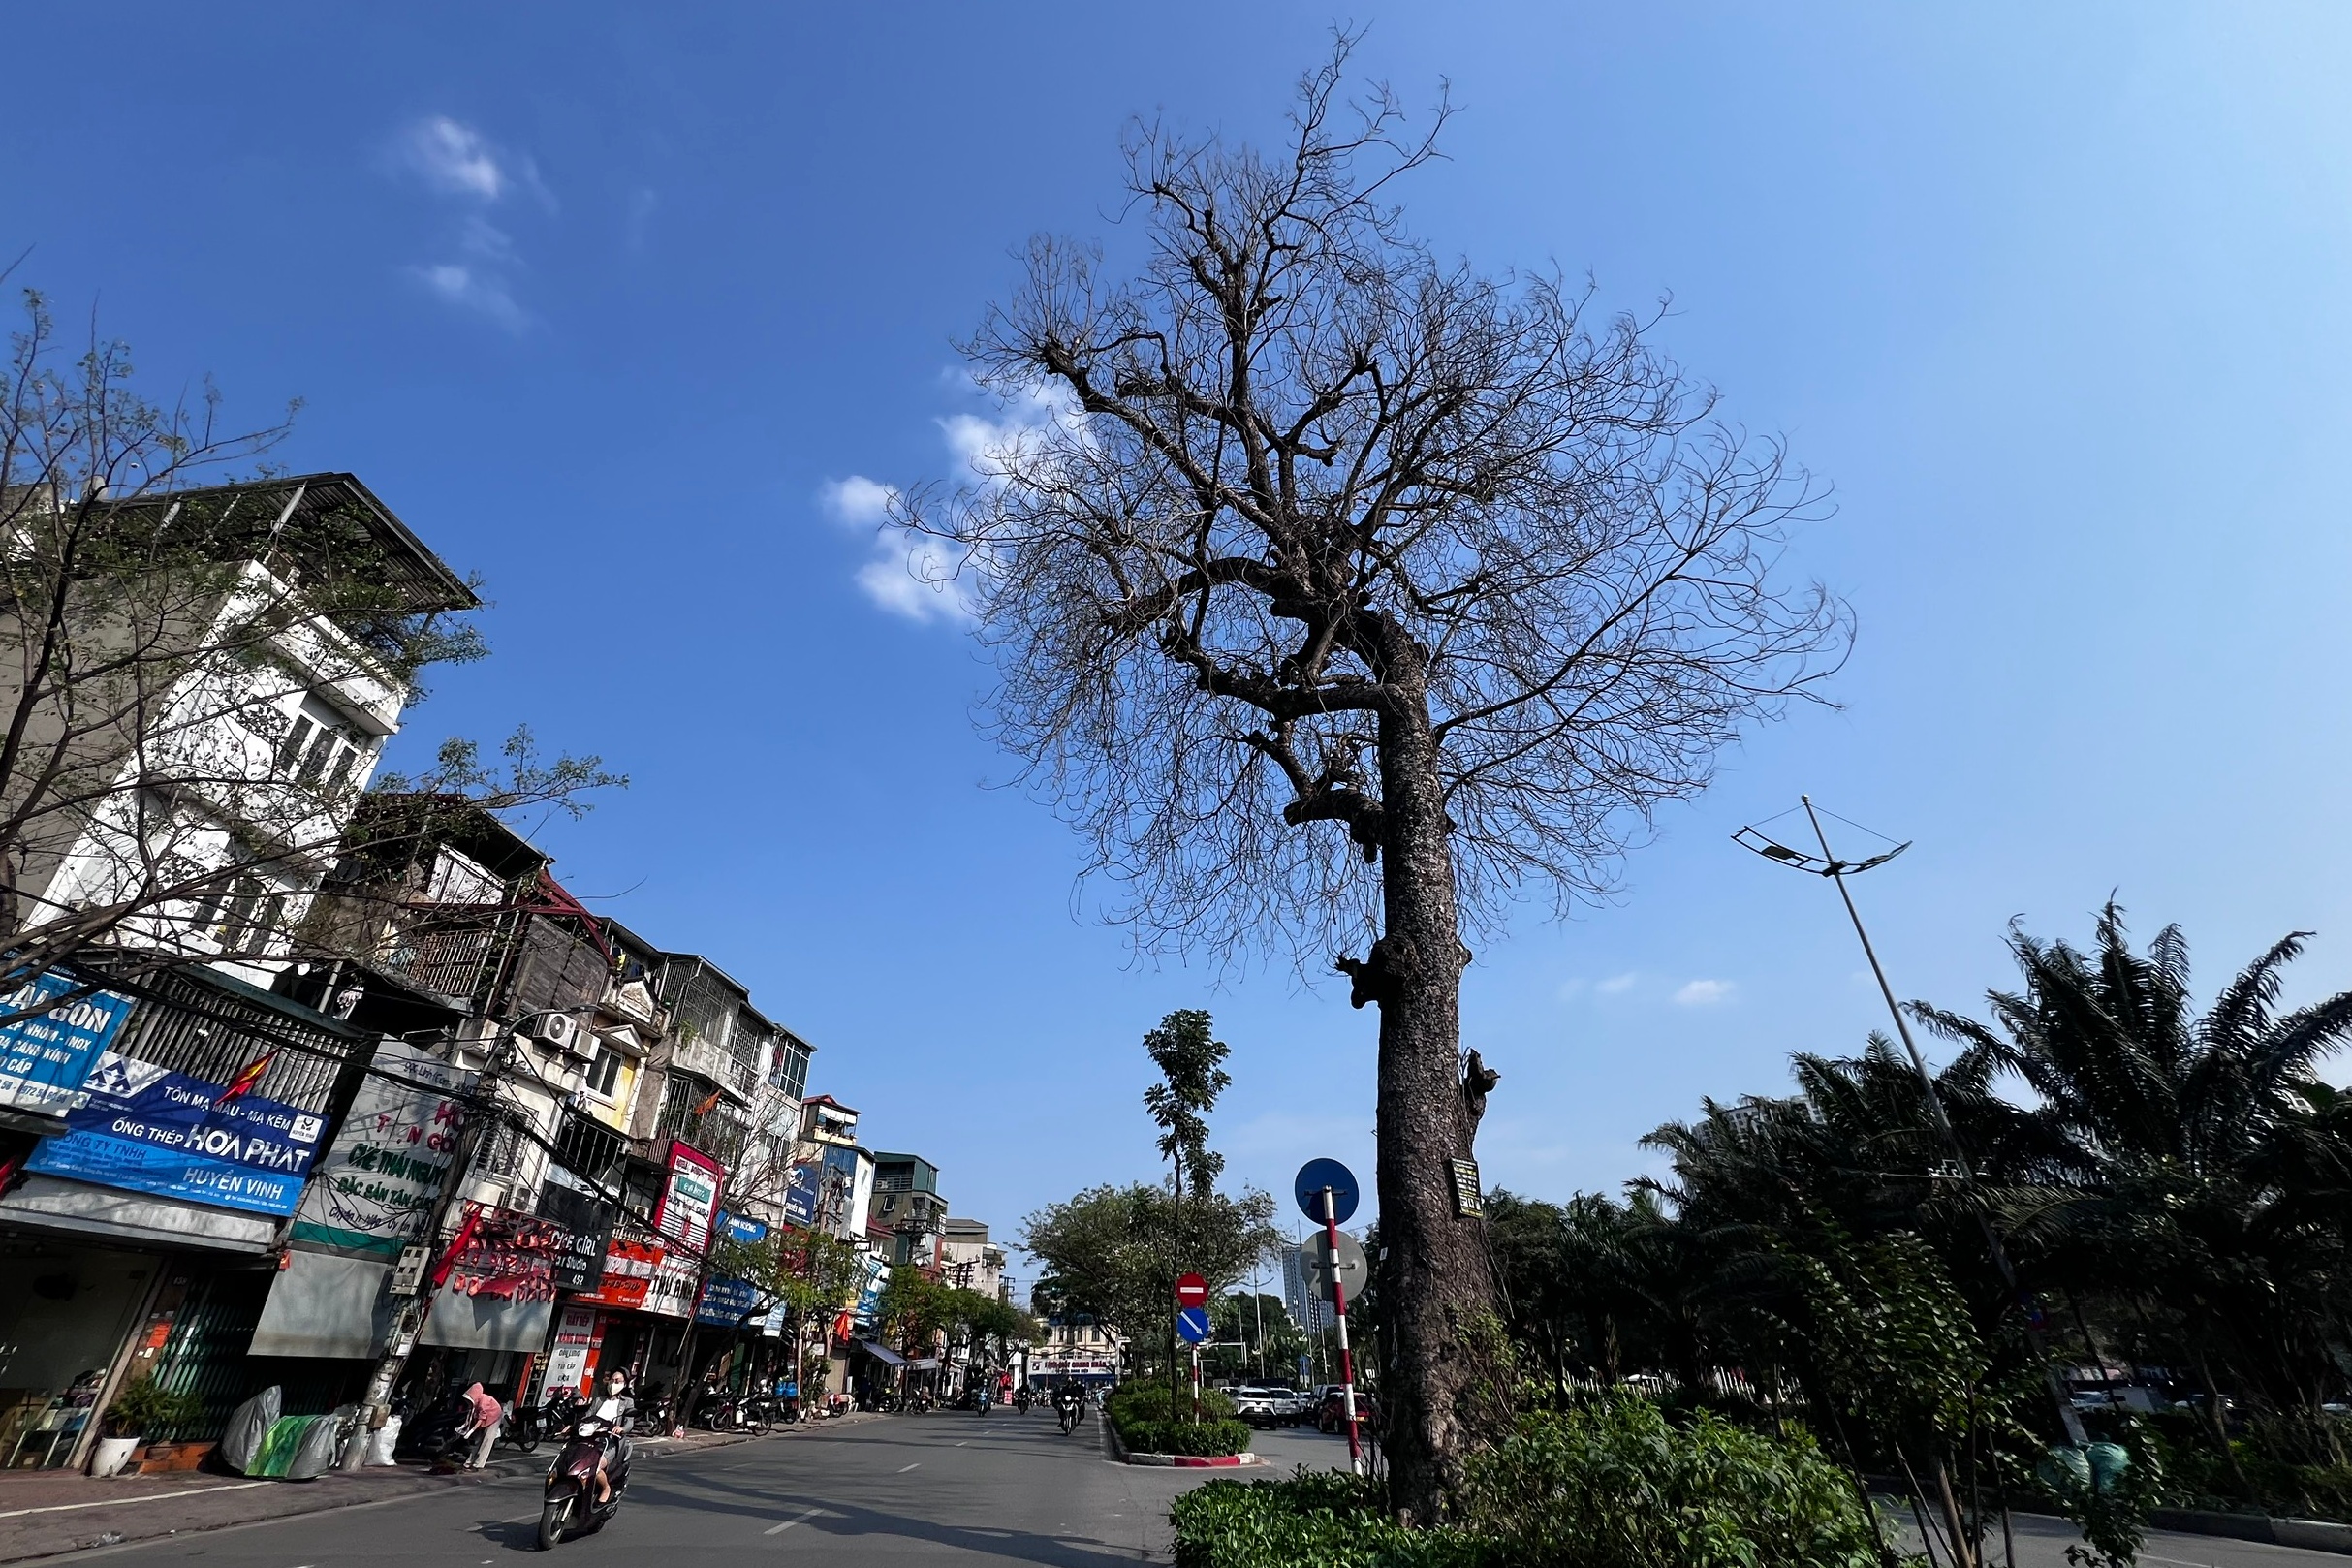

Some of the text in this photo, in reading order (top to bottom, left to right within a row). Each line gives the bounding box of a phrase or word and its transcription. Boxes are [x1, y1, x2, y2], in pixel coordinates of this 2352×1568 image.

[64, 1035, 92, 1051] INOX
[42, 1048, 72, 1065] KÍNH
[164, 1086, 192, 1104] TÔN
[191, 1094, 211, 1112] MẠ
[246, 1110, 265, 1126] MẠ
[111, 1115, 145, 1140] ỐNG
[147, 1127, 184, 1145] THÉP
[243, 1137, 311, 1172] PHÁT
[246, 1178, 284, 1201] VINH
[572, 1274, 584, 1286] 452
